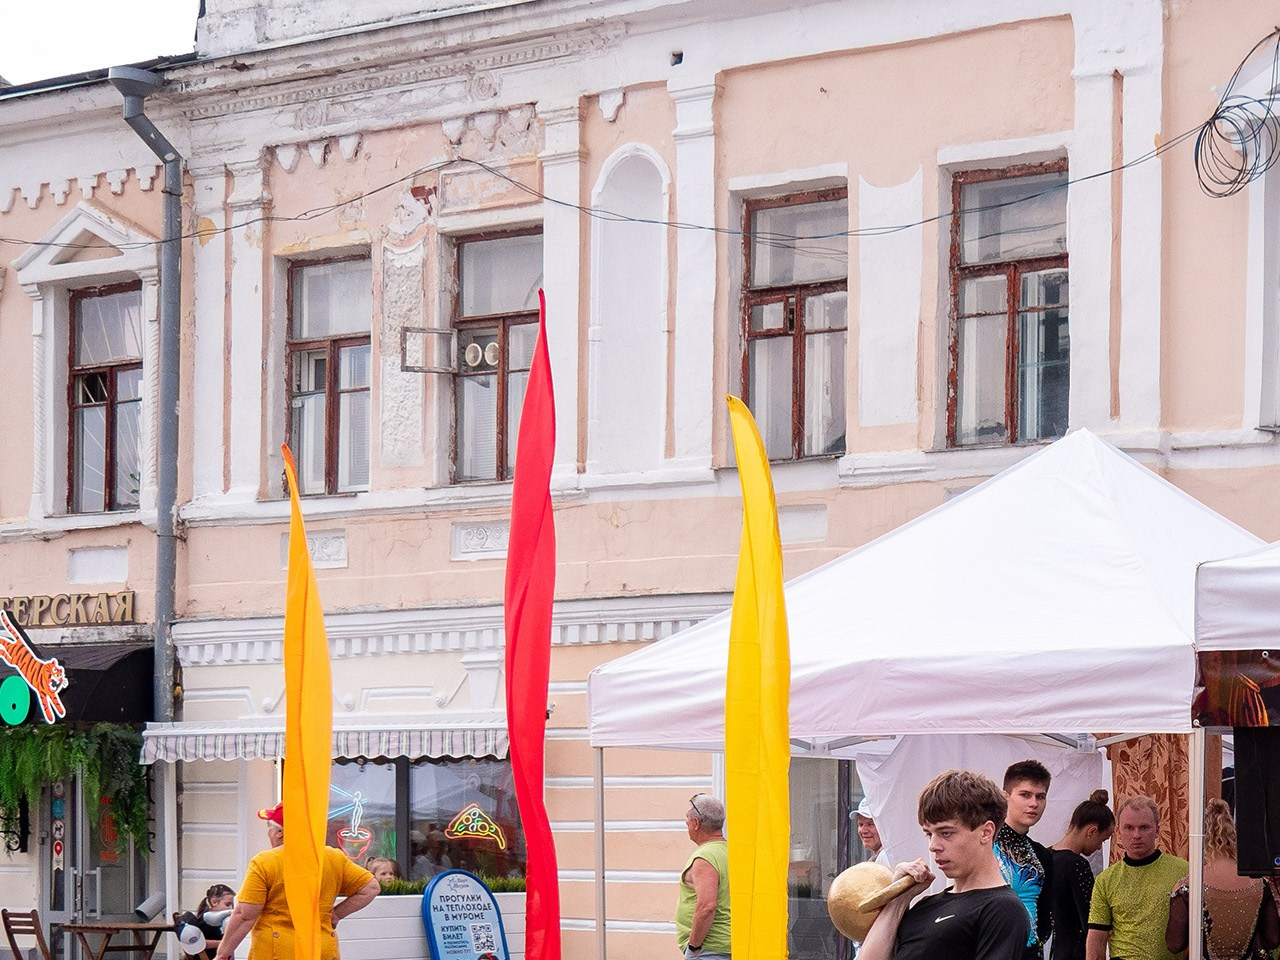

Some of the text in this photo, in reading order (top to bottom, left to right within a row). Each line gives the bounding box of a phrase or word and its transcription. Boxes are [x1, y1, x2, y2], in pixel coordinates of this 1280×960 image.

[440, 895, 482, 903] ПРОГУЛКИ
[433, 903, 492, 912] НА ТЕПЛОХОДЕ
[452, 912, 485, 921] МУРОМЕ
